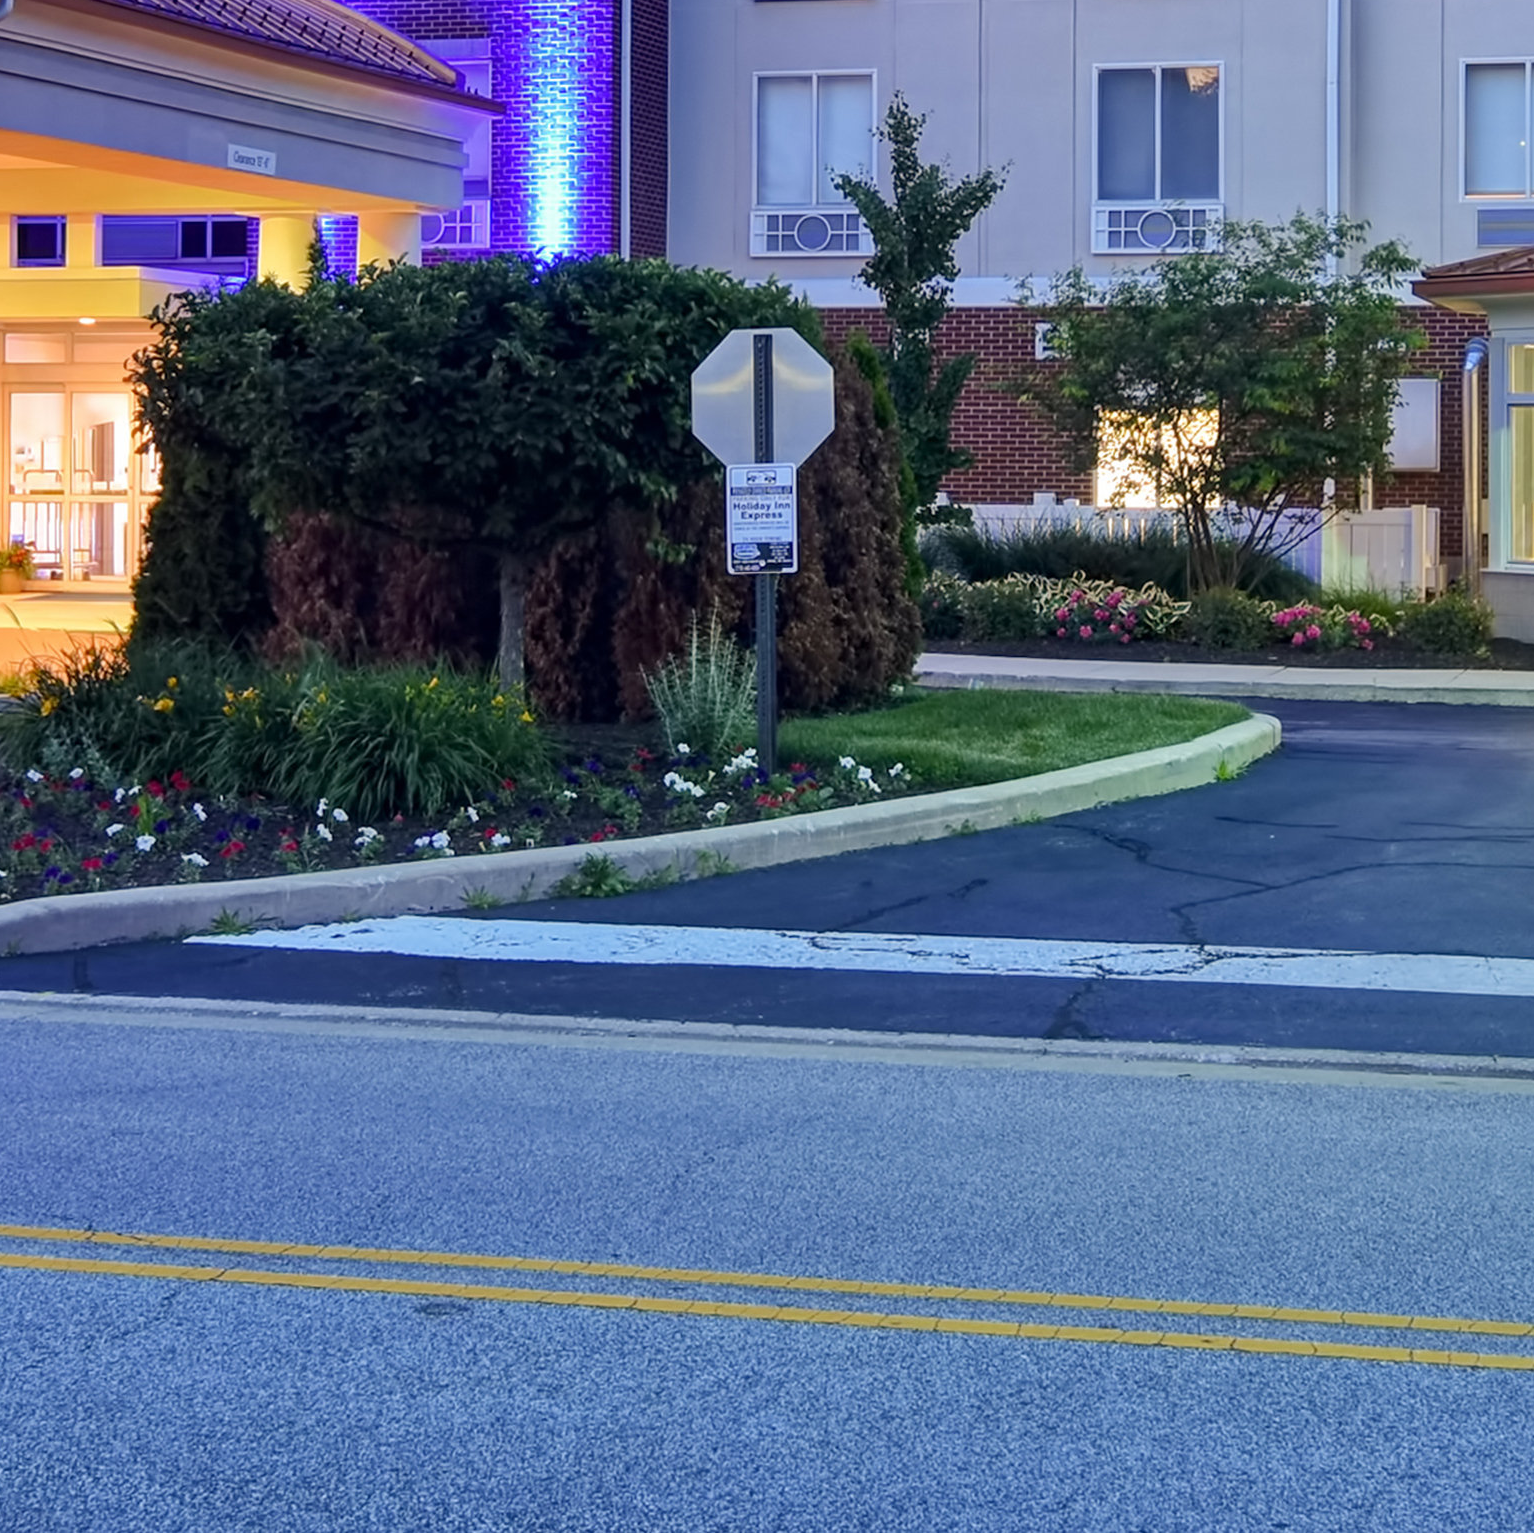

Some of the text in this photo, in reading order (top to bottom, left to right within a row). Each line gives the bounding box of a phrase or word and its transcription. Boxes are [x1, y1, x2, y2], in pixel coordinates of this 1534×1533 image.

[733, 501, 791, 512] Holiday Inn
[741, 511, 783, 521] Express
